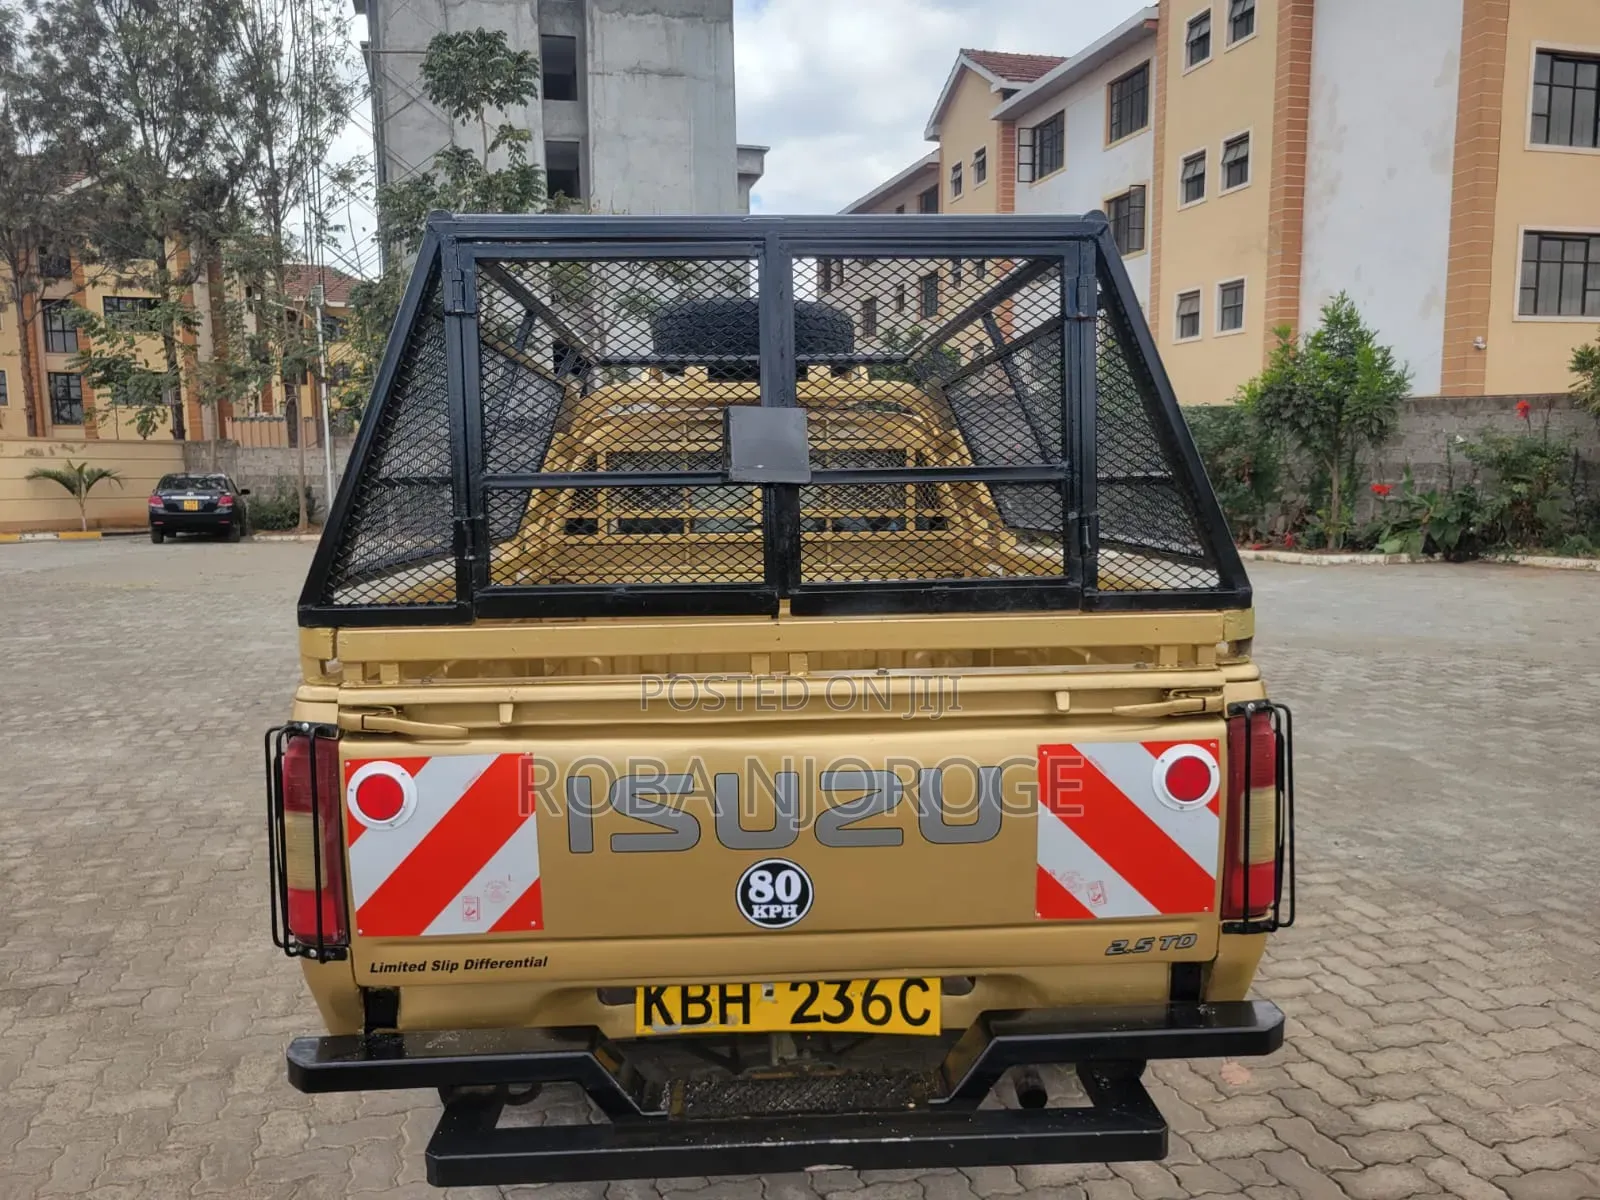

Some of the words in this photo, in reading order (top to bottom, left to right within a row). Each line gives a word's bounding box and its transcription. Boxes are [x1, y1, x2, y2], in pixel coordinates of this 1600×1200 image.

[566, 766, 1003, 854] ISUZU
[748, 869, 802, 904] 80
[751, 903, 799, 919] KPH
[1104, 936, 1156, 957] 2.5
[369, 960, 428, 974] Limited
[431, 960, 460, 974] Slip
[463, 955, 549, 971] Differential
[643, 982, 751, 1027] KBH
[788, 977, 932, 1027] 236C
